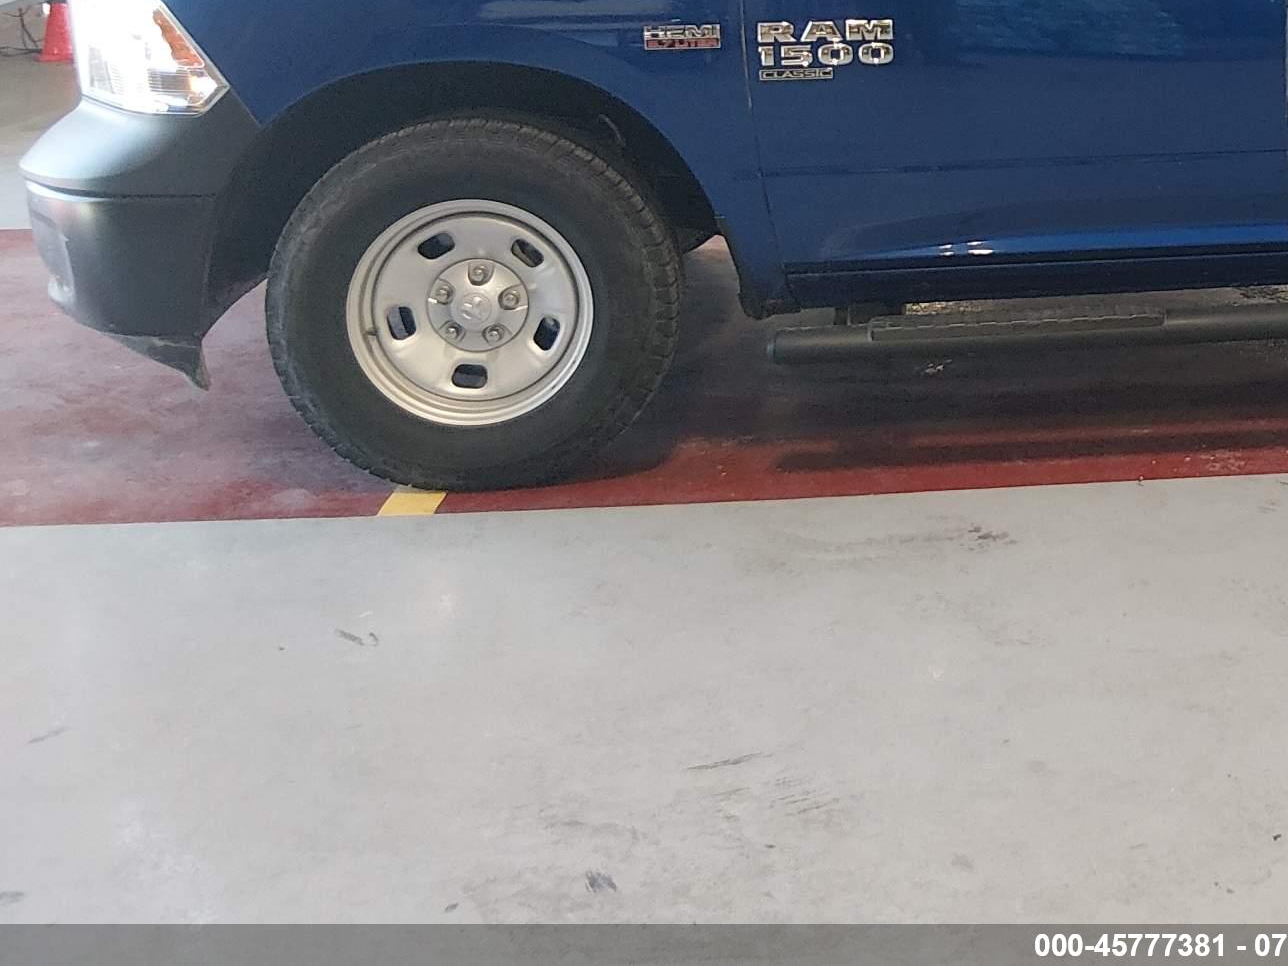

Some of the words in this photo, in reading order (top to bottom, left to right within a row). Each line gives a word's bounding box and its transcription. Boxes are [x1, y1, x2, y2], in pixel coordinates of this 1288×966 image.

[643, 24, 721, 39] HEMI
[757, 19, 894, 43] RAM
[757, 42, 895, 67] 1500
[761, 68, 833, 80] CLASSIC
